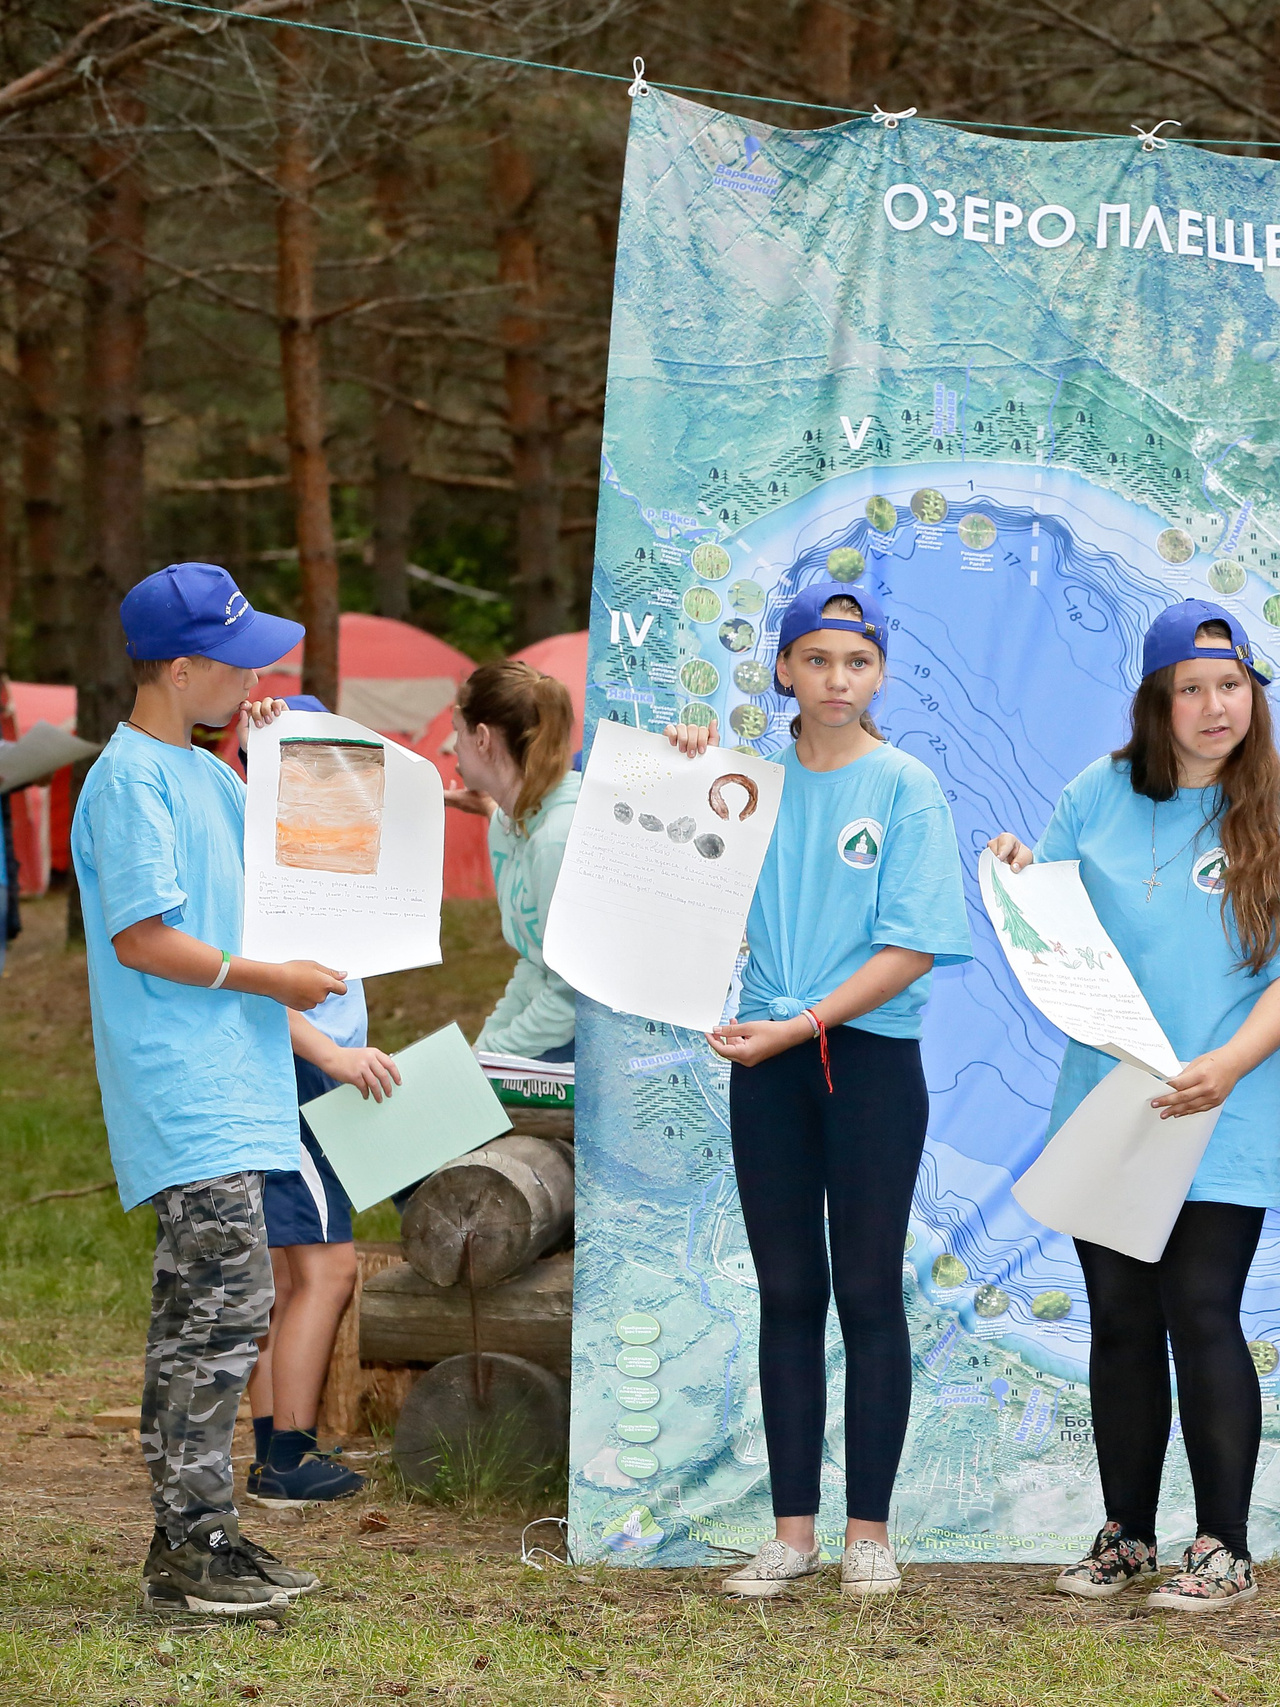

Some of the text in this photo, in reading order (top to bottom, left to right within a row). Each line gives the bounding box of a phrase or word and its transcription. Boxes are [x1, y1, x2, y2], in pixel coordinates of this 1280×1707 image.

[716, 164, 778, 186] Варварин
[713, 177, 777, 196] источник
[884, 183, 1076, 249] ОЗЕРО
[840, 416, 872, 450] V
[662, 510, 697, 527] Вёкса
[1223, 501, 1252, 553] Кухмарка
[1003, 551, 1021, 567] 17
[877, 581, 893, 597] 17
[1066, 604, 1083, 621] 18
[610, 610, 655, 647] IV
[884, 616, 901, 631] 18
[912, 664, 931, 679] 19
[920, 694, 939, 712] 20
[928, 735, 948, 755] 22
[630, 1049, 694, 1069] Павловка
[942, 1384, 980, 1396] Ключ
[935, 1395, 988, 1407] Гремяч
[1014, 1389, 1041, 1442] Матросов
[1034, 1402, 1050, 1435] овраг
[1064, 1416, 1094, 1428] Бот
[1060, 1430, 1096, 1443] Пет
